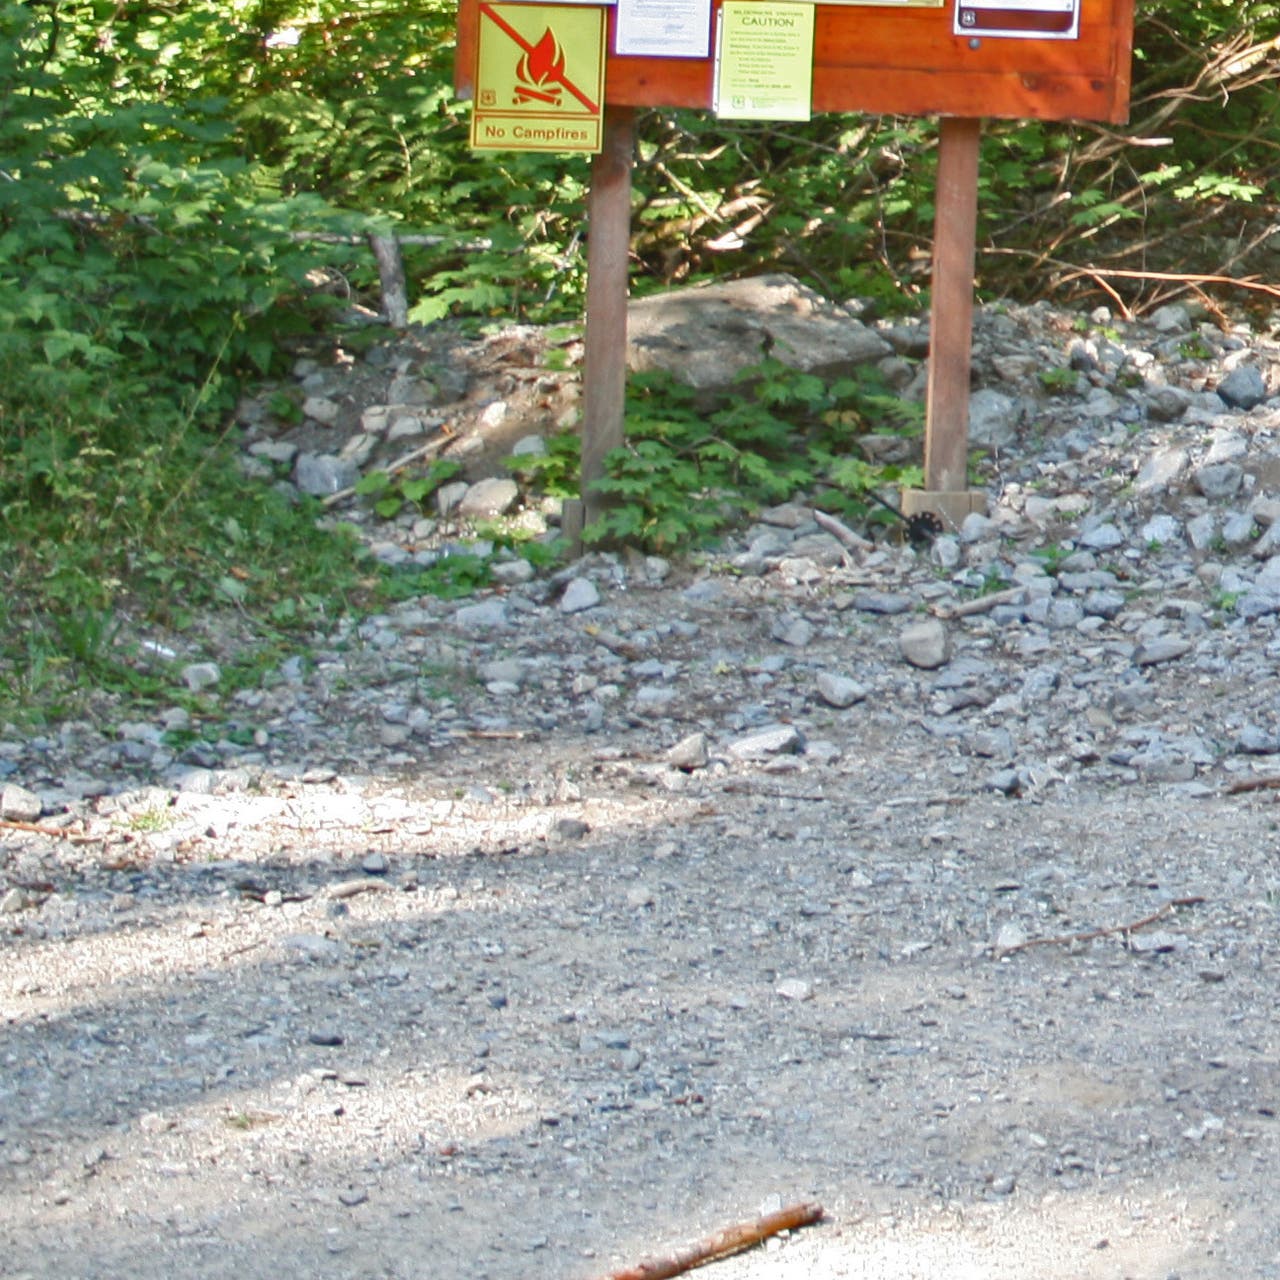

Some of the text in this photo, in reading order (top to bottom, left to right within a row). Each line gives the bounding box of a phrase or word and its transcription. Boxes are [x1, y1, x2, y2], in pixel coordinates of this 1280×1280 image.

[742, 17, 794, 27] CAUTION
[485, 125, 588, 142] No Campfires
